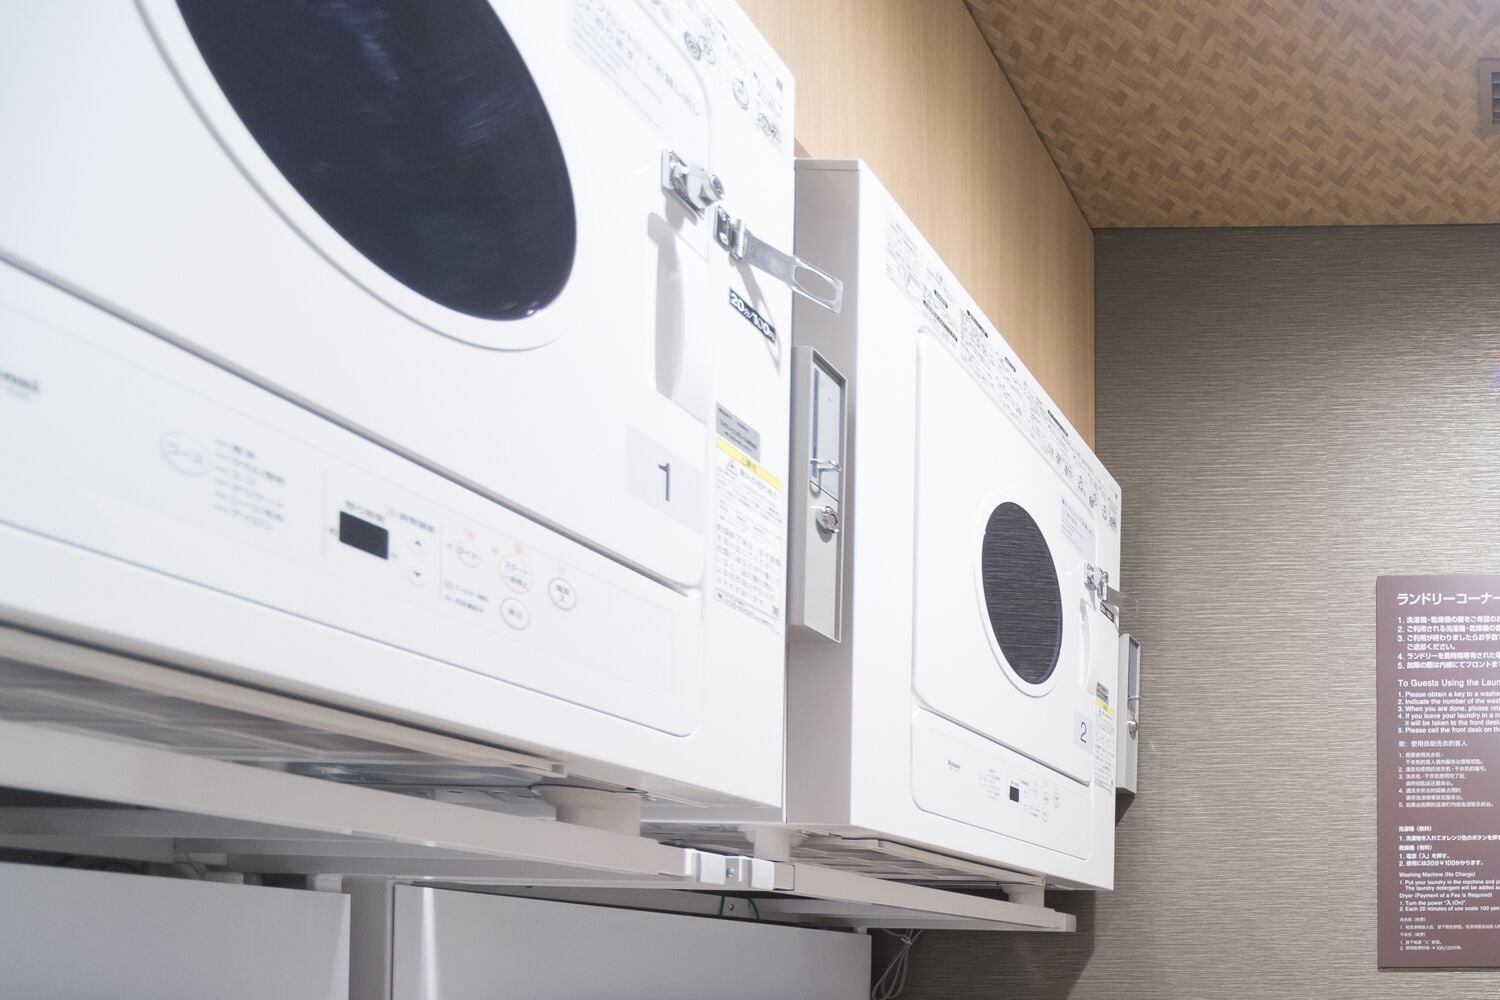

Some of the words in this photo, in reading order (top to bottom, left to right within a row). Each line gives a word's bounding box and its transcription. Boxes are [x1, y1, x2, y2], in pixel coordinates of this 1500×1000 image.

[658, 463, 670, 502] 1
[1398, 679, 1408, 687] To
[1411, 679, 1439, 687] Guests
[1441, 679, 1464, 687] Using
[1080, 721, 1087, 743] 2
